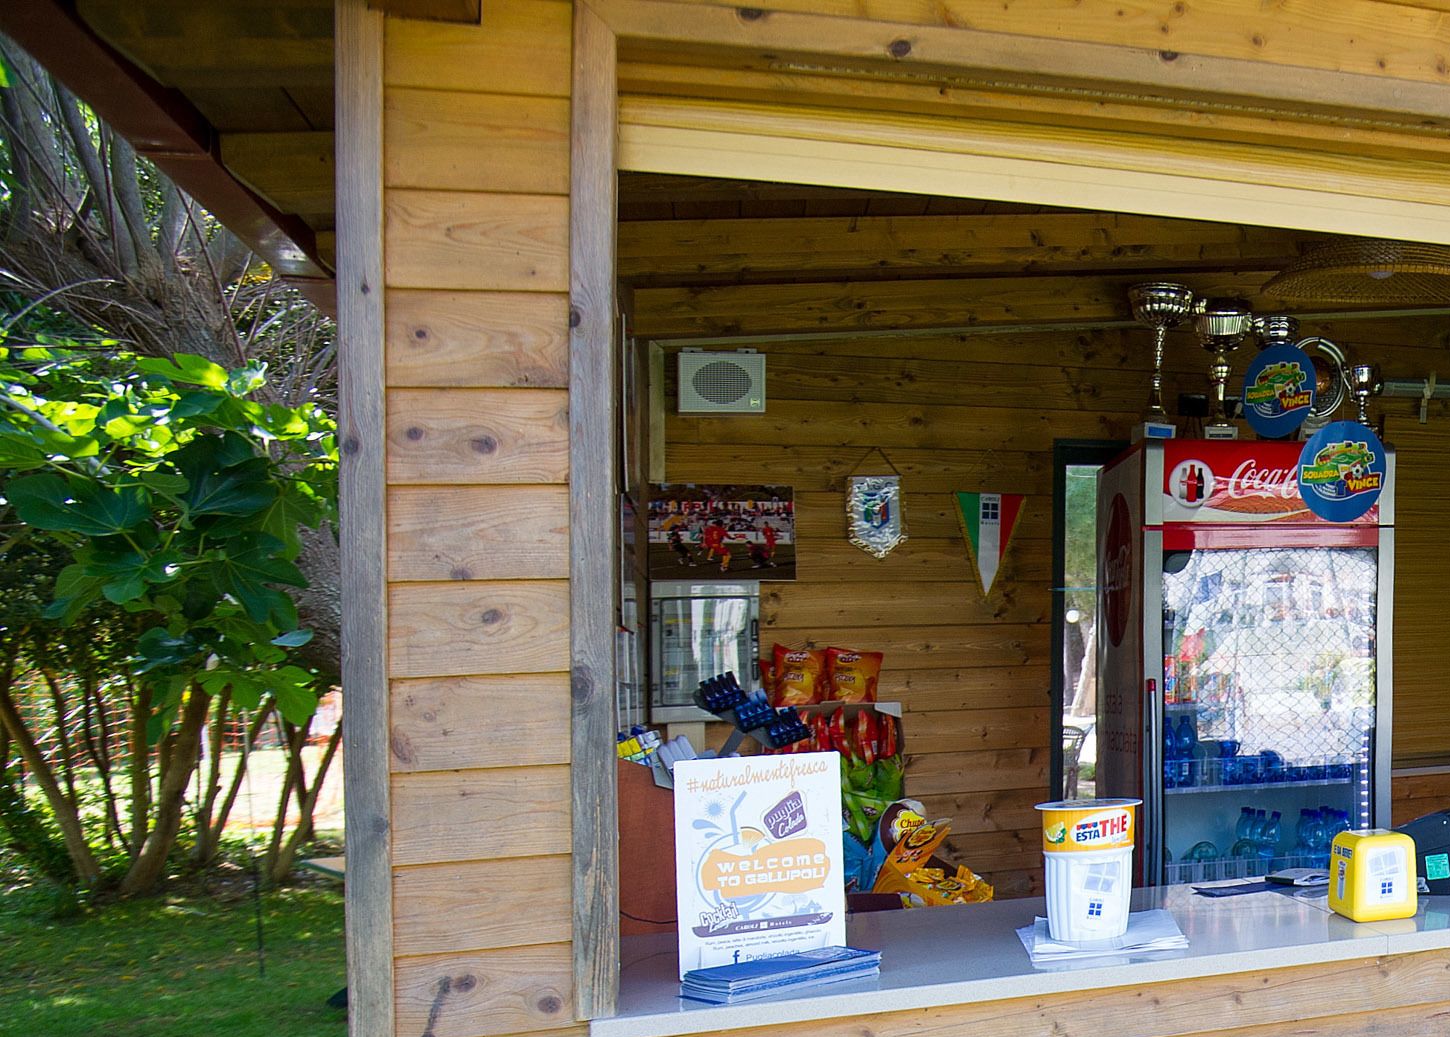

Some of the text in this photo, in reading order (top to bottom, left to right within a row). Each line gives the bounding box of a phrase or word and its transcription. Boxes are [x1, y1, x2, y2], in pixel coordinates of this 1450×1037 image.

[1281, 395, 1310, 408] VINCE
[1228, 459, 1301, 500] Coca-C
[1303, 470, 1340, 480] SQUADRA
[1347, 477, 1379, 491] VINCE
[687, 759, 829, 794] #naturalmentefresca
[766, 797, 804, 831] puglia
[778, 812, 805, 837] Colada
